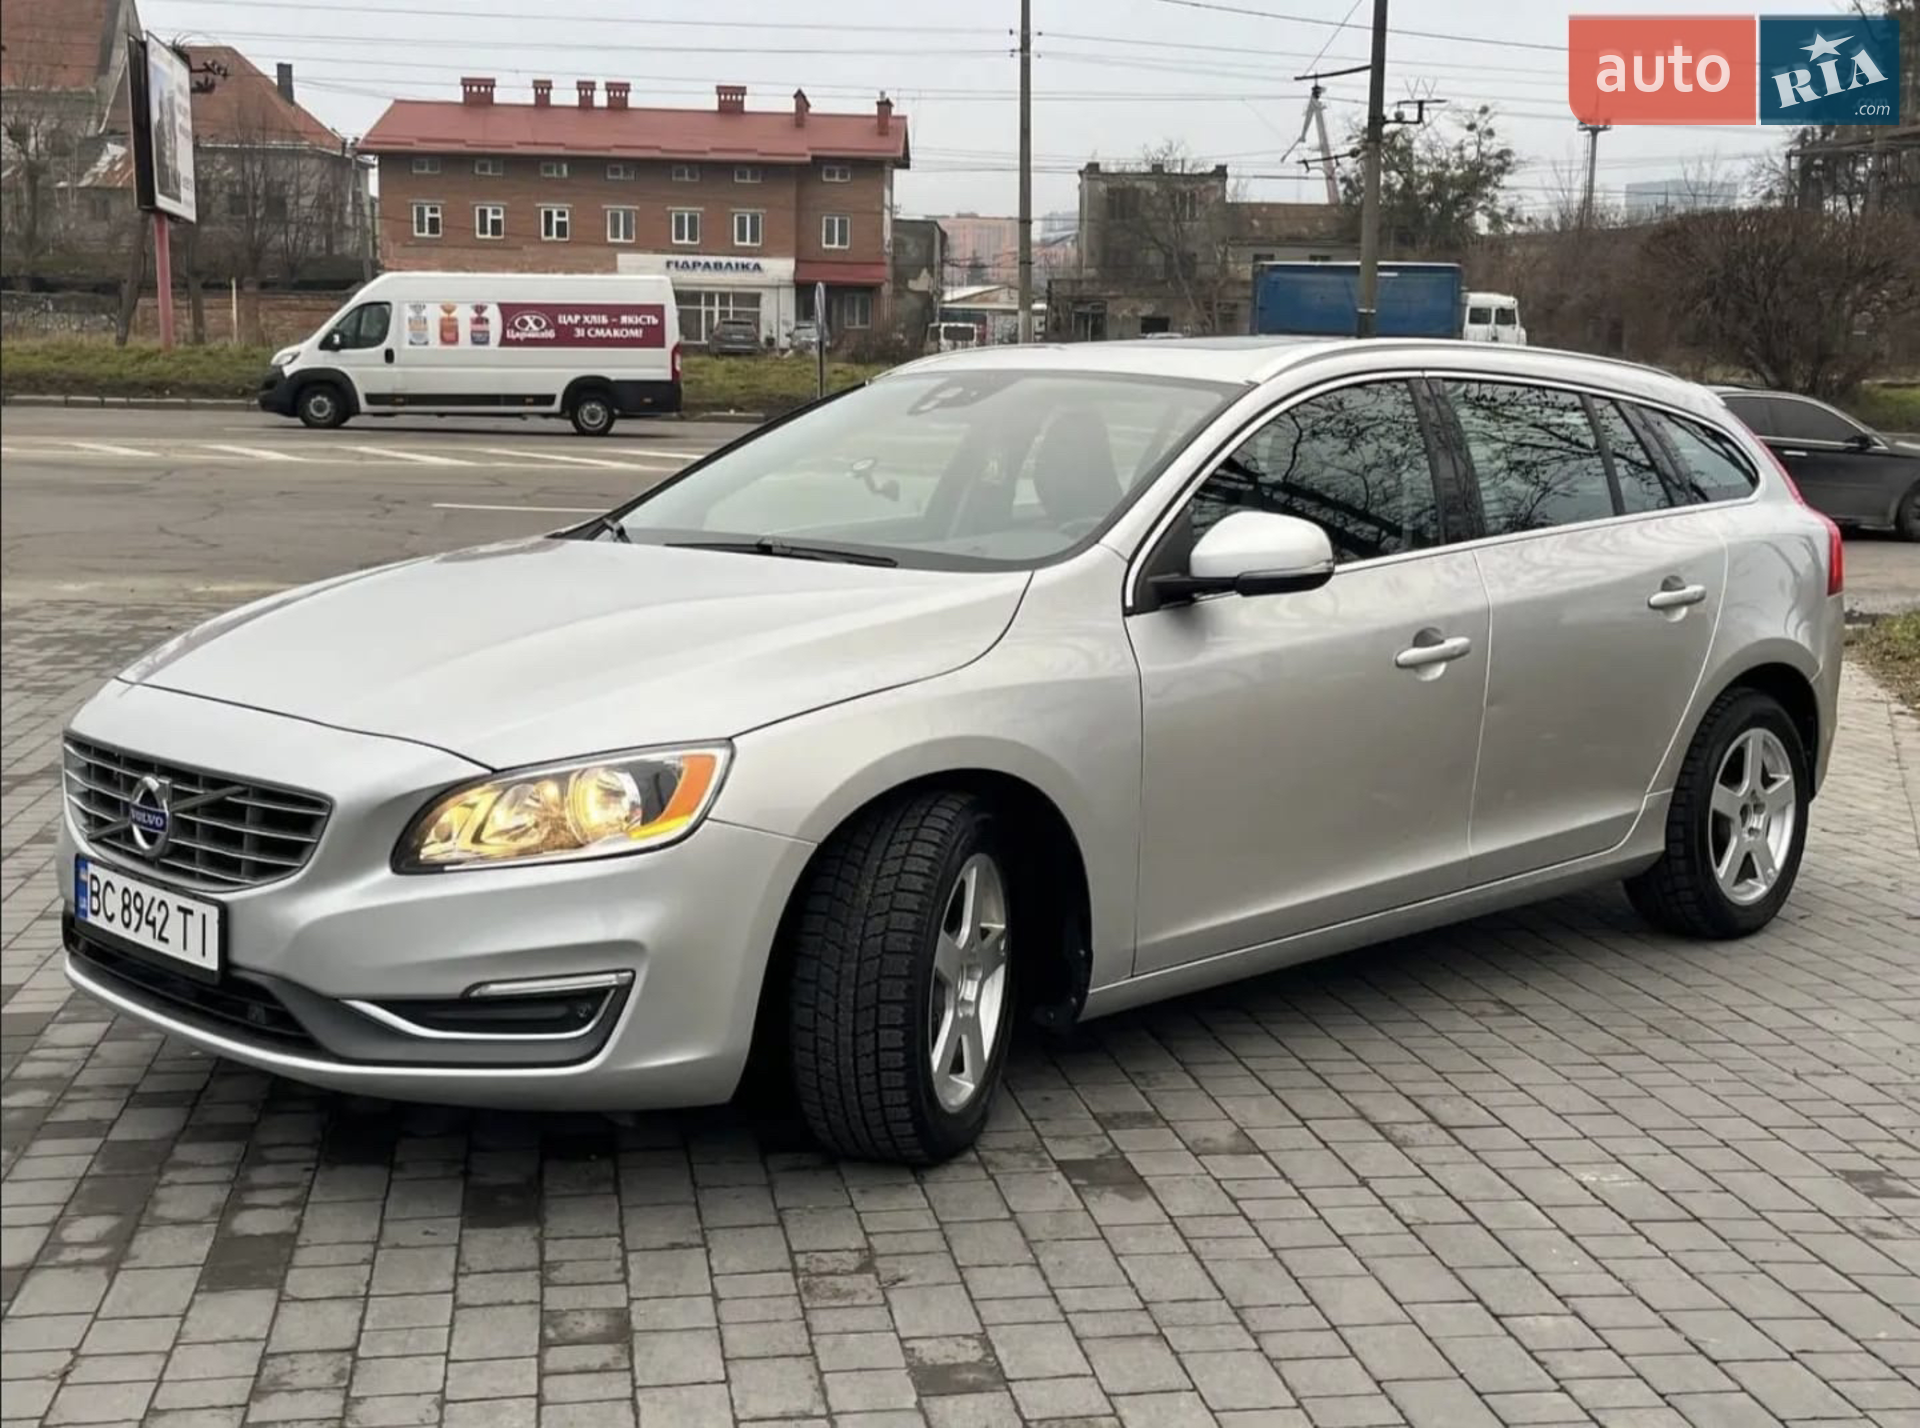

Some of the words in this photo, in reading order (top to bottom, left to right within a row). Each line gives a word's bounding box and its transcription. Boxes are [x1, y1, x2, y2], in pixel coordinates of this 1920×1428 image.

[665, 260, 764, 273] ГІДРАВЛІКА
[557, 313, 581, 326] ЦАР
[582, 314, 609, 325] ХЛІБ
[620, 315, 659, 325] ЯКІСТЬ
[573, 328, 586, 338] ЗІ
[587, 328, 643, 339] СМАКОМ!
[90, 873, 116, 923] BC
[121, 886, 170, 945] 8942
[176, 904, 206, 958] TI
